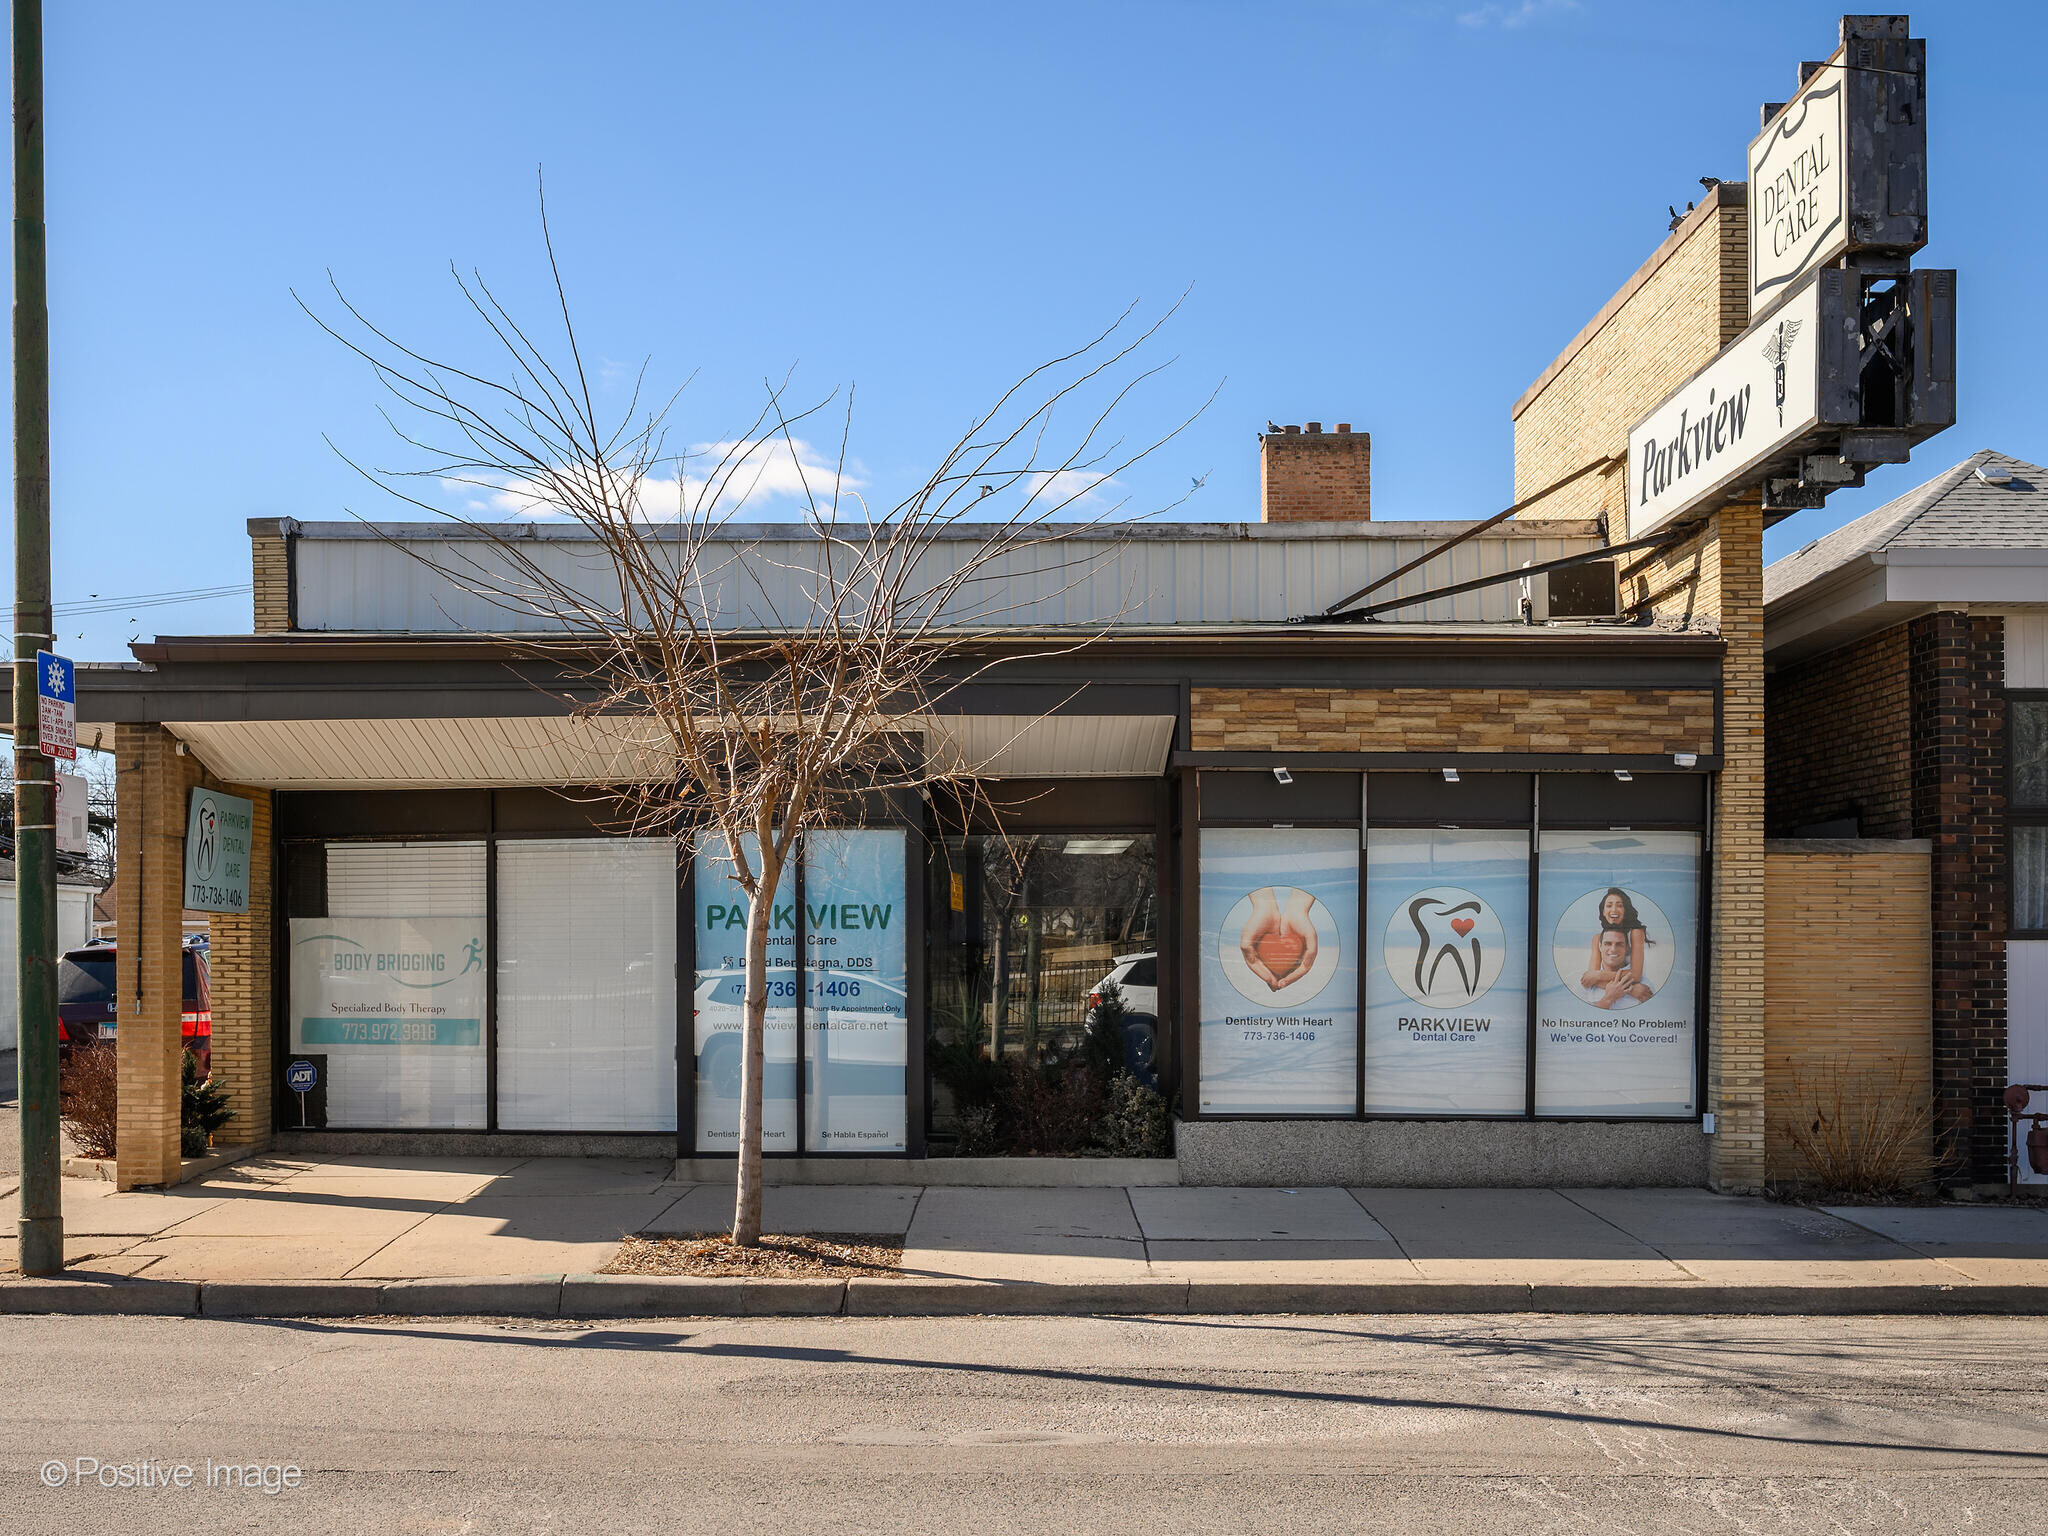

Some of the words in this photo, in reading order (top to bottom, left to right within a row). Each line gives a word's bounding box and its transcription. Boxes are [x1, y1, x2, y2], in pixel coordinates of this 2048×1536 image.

[1763, 133, 1830, 227] DENTAL
[1773, 185, 1820, 258] CARE
[1640, 383, 1752, 507] Parkview
[40, 697, 48, 705] NO
[48, 698, 65, 710] PARKING
[42, 714, 50, 723] DEC
[67, 720, 73, 728] OR
[42, 723, 54, 732] WHEN
[55, 726, 67, 735] SNOW
[42, 731, 53, 741] OVER
[59, 735, 74, 746] INCHES
[42, 743, 56, 754] TOW
[57, 746, 74, 759] ZONE
[220, 811, 249, 831] PARKVIEW
[223, 837, 246, 854] DENTAL
[225, 862, 240, 878] CARE
[192, 884, 242, 907] 773-736-1406
[806, 934, 837, 945] Care
[334, 953, 372, 971] BODY
[377, 953, 445, 971] BRIDGING
[847, 957, 873, 968] DDS
[331, 1002, 382, 1014] Specialized
[384, 1002, 407, 1015] Body
[409, 1002, 447, 1015] Therapy
[830, 1005, 840, 1015] By
[841, 1005, 885, 1015] Appointment
[885, 1005, 902, 1015] Only
[1225, 1016, 1274, 1028] Dentistry
[1276, 1017, 1300, 1026] With
[1303, 1017, 1333, 1026] Heart
[1398, 1017, 1491, 1032] PARKVIEW
[1542, 1018, 1556, 1028] No
[1559, 1018, 1618, 1028] Insurance?
[1621, 1019, 1636, 1028] No
[1638, 1019, 1687, 1029] Problem!
[1243, 1031, 1315, 1041] 773-736-1406
[1413, 1032, 1447, 1041] Dental
[1450, 1032, 1476, 1041] Care
[1585, 1033, 1605, 1043] Got
[1607, 1033, 1626, 1043] You
[1629, 1033, 1678, 1043] Covered!
[292, 1070, 312, 1082] ADT
[763, 1130, 785, 1138] Heart
[821, 1130, 832, 1138] Se
[833, 1130, 855, 1138] Habla
[857, 1129, 889, 1140] Español
